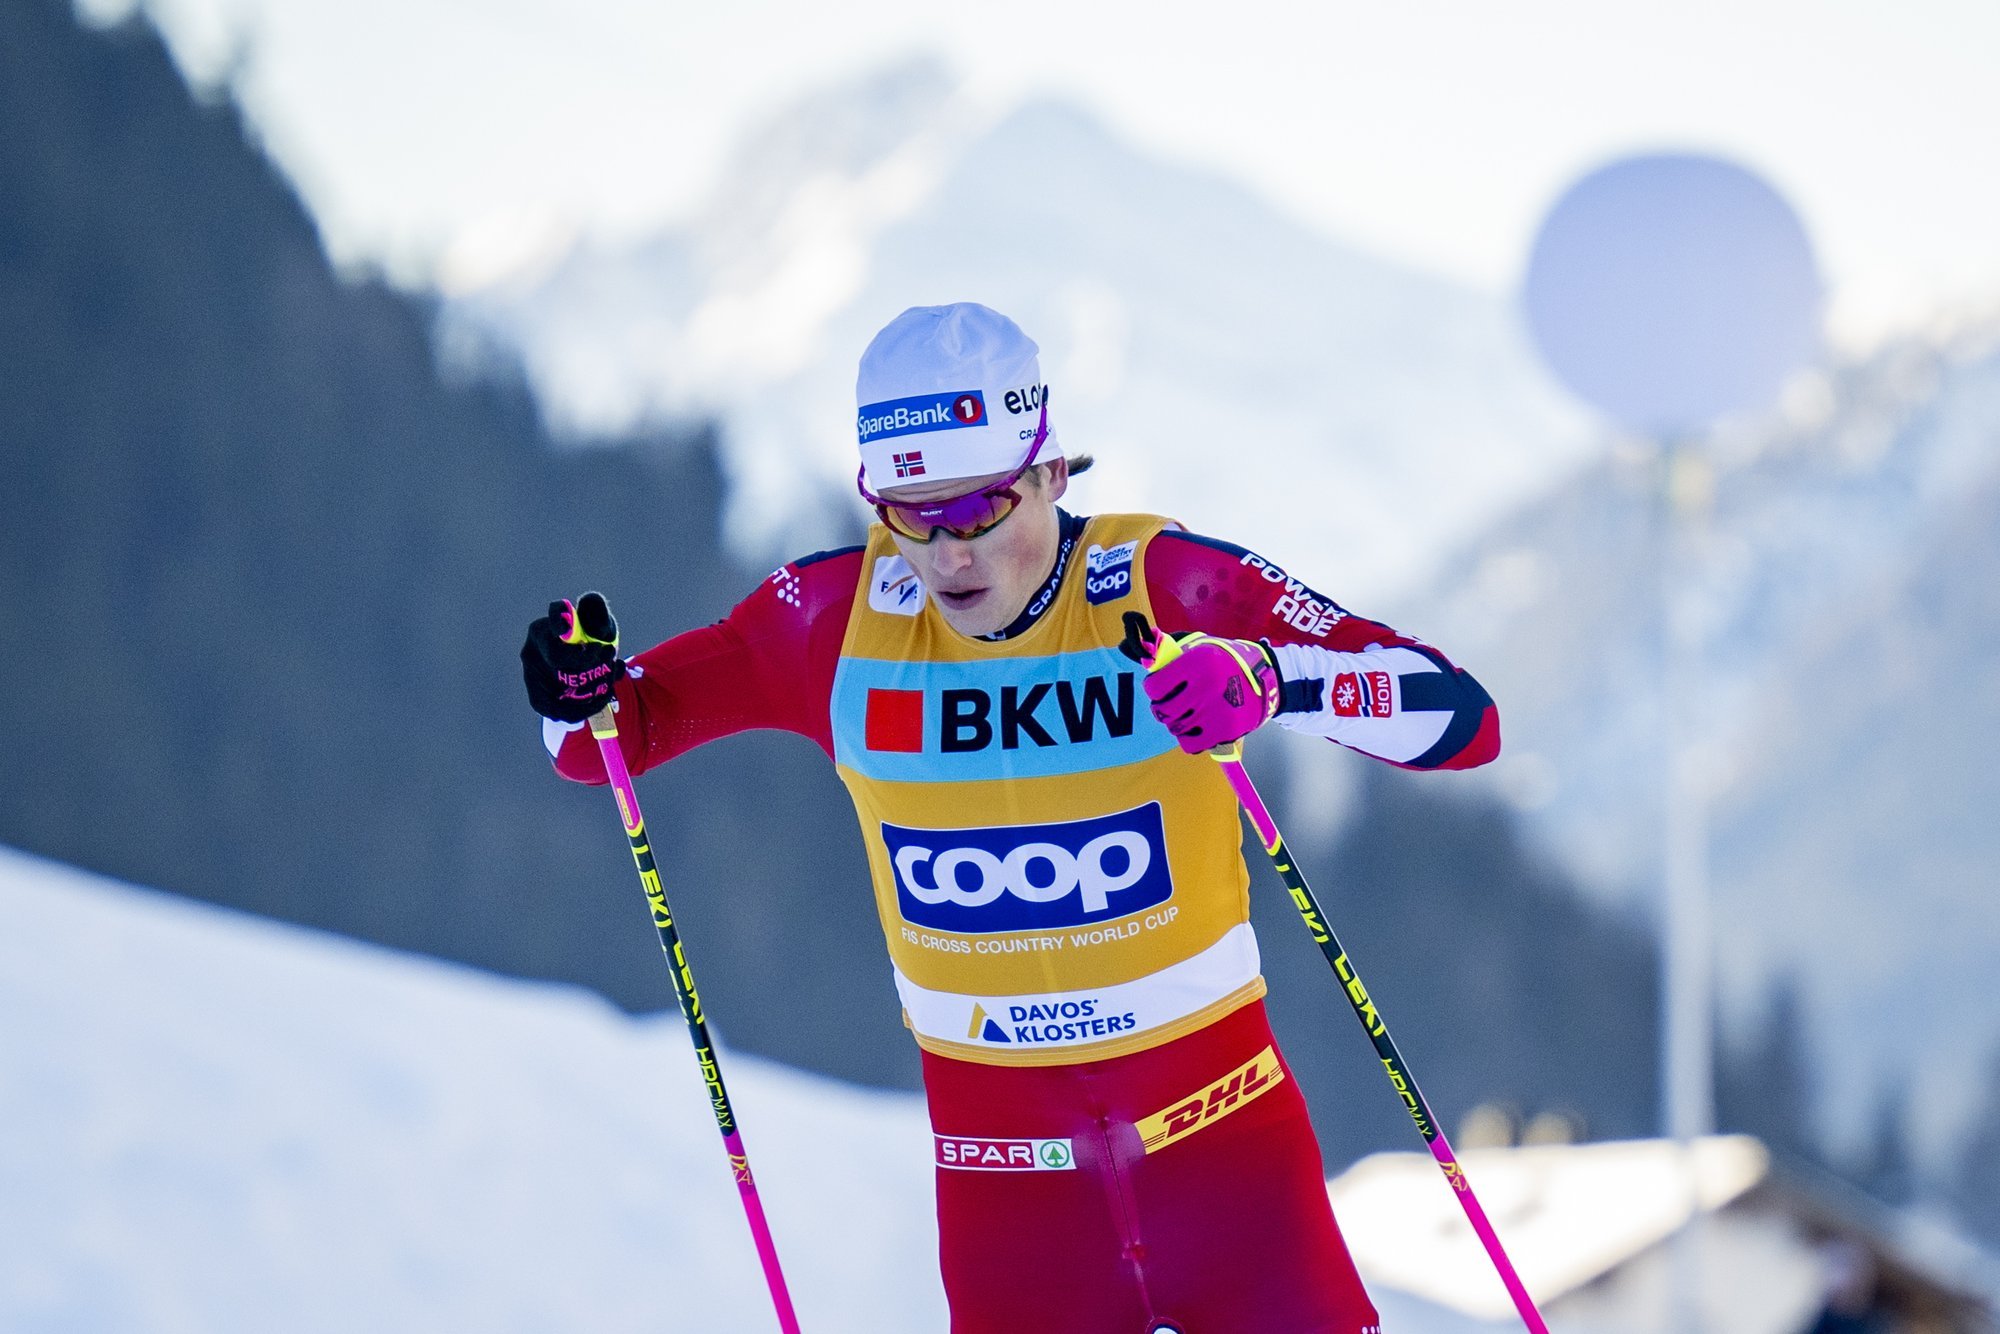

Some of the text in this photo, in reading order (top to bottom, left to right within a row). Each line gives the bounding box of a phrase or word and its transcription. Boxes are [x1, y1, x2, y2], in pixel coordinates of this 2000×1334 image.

[858, 399, 975, 440] SpareBank 1
[1028, 552, 1066, 616] CRAFT
[1087, 571, 1129, 594] coop
[1271, 594, 1339, 638] ADE
[557, 663, 612, 688] HESTRA
[1376, 674, 1390, 715] NOR
[940, 671, 1135, 753] BKW
[631, 844, 673, 928] LEKI
[895, 830, 1151, 913] coop
[901, 906, 1179, 955] FIS CROSS COUNTRY WORLD CUP
[1009, 999, 1095, 1023] DAVOS
[1014, 1012, 1136, 1043] KLOSTERS
[1162, 1062, 1270, 1139] DHL
[942, 1141, 1033, 1165] SPAR
